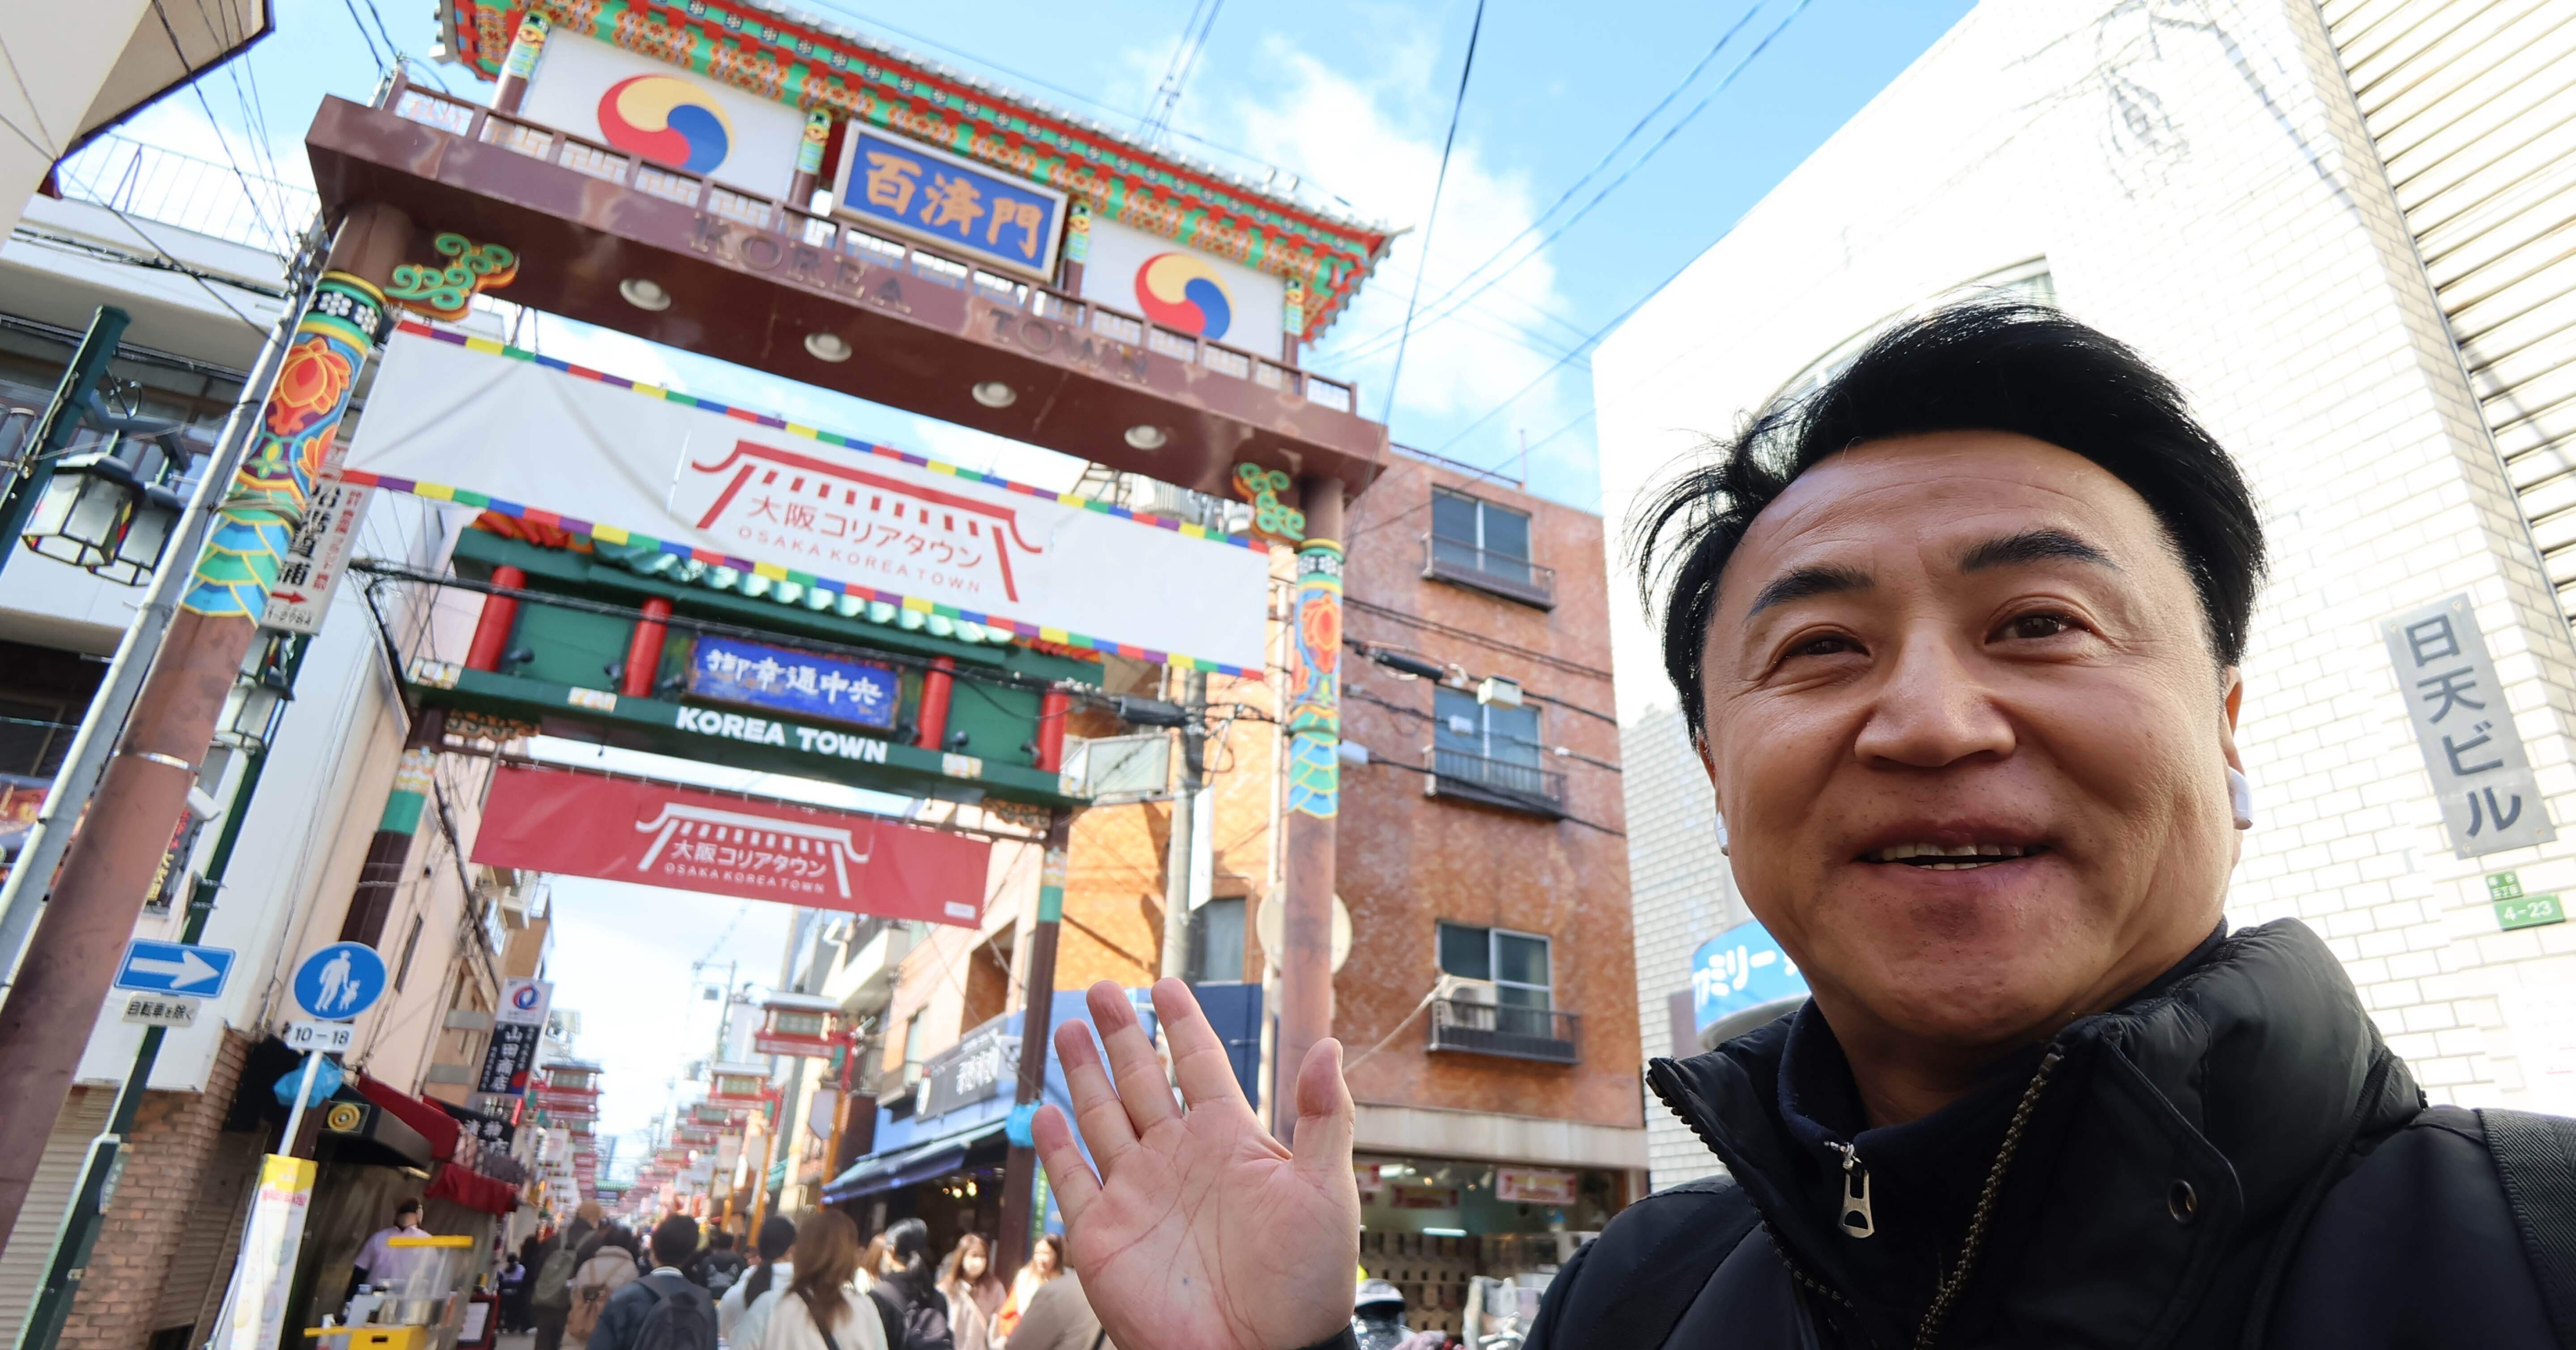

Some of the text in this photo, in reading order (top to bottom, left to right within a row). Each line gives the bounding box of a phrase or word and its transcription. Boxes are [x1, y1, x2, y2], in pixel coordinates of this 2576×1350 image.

[690, 210, 1149, 386] KOREA TOWN
[738, 525, 981, 593] OSAKA KOREA TOWN
[747, 495, 983, 569] 大阪コリアタウン
[675, 706, 888, 763] KOREA TOWN
[2404, 614, 2522, 838] 日天ビル
[664, 862, 825, 894] OSAKA KOREA TOWN
[670, 838, 827, 879] 大阪コリアタウン
[2504, 900, 2553, 921] 4-23
[127, 1001, 195, 1020] 自転車を除く
